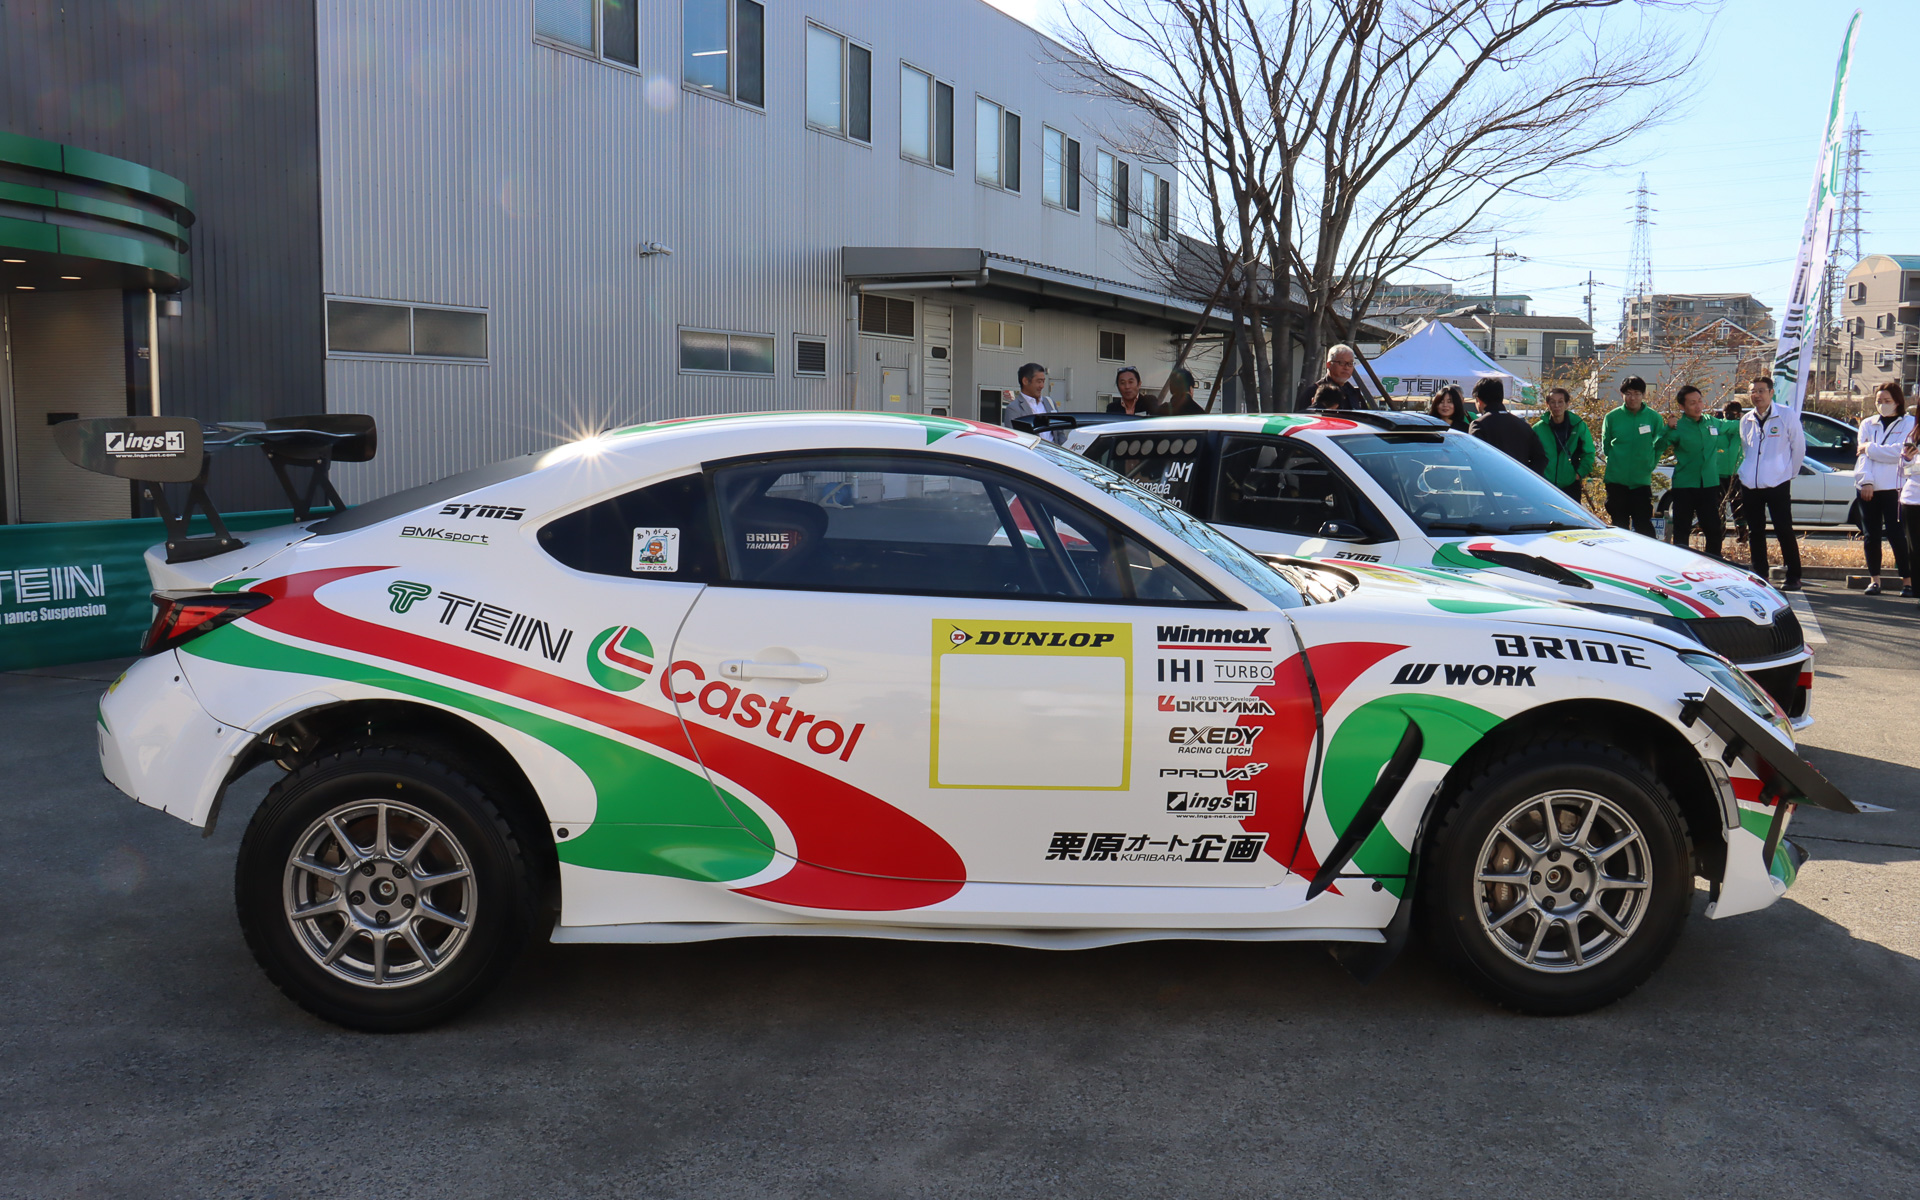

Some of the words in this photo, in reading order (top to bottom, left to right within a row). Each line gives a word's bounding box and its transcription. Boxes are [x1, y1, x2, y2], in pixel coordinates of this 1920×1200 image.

[126, 432, 165, 451] ings
[1165, 462, 1194, 482] JN1
[746, 533, 789, 542] BRIDE
[40, 603, 107, 621] Suspension
[438, 591, 574, 664] TEIN
[975, 631, 1115, 648] DUNLOP
[1491, 634, 1652, 670] BRIDE
[1158, 659, 1203, 682] IHI
[1215, 665, 1273, 679] TURBO
[1443, 664, 1537, 687] WORK
[660, 660, 866, 763] Castrol
[1168, 726, 1263, 745] EXEDY
[1178, 746, 1213, 754] RACING
[1214, 747, 1251, 755] CLUTCH
[1159, 768, 1250, 779] PROVA
[1188, 792, 1234, 812] ings
[1045, 832, 1267, 863] 栗原オート企画
[1120, 854, 1184, 862] KURIBARA
